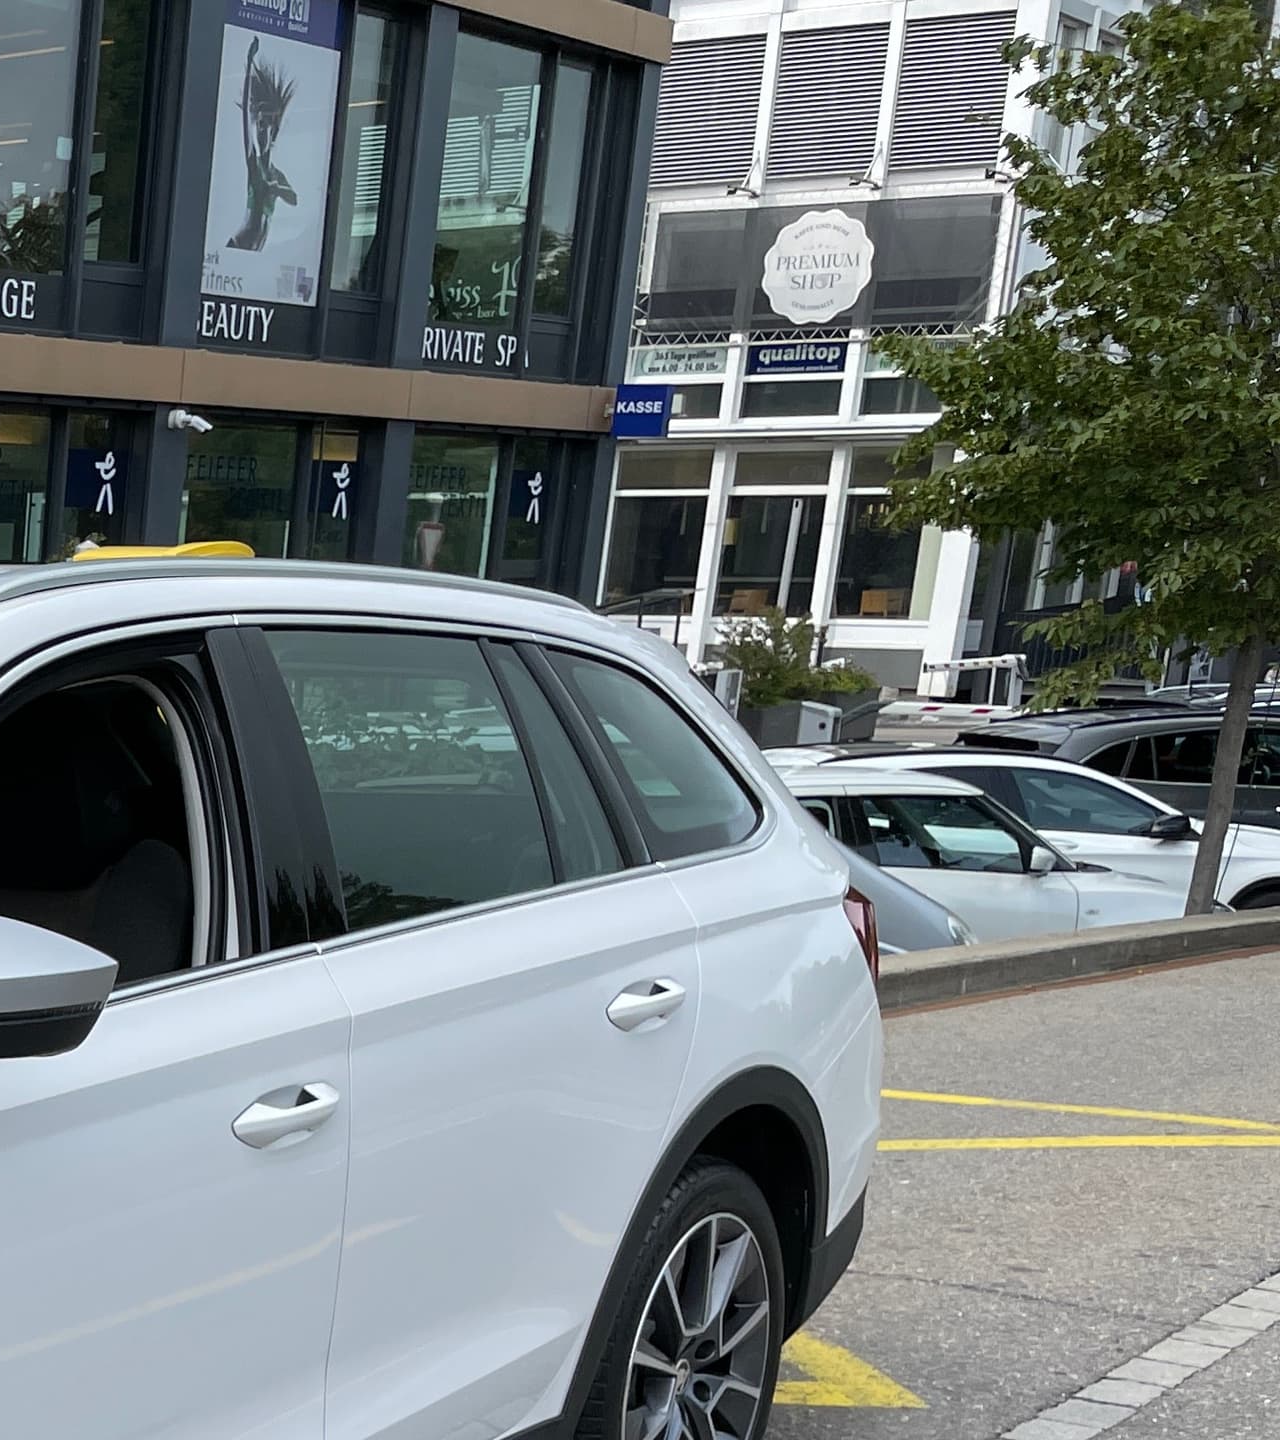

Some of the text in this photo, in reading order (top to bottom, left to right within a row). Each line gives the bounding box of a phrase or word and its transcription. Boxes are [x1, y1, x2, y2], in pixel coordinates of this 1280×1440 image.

[776, 252, 860, 271] PREMIUM
[790, 272, 842, 290] SHOP
[197, 300, 274, 342] EAUTY
[759, 344, 841, 365] qualitop
[616, 400, 663, 414] KASSE
